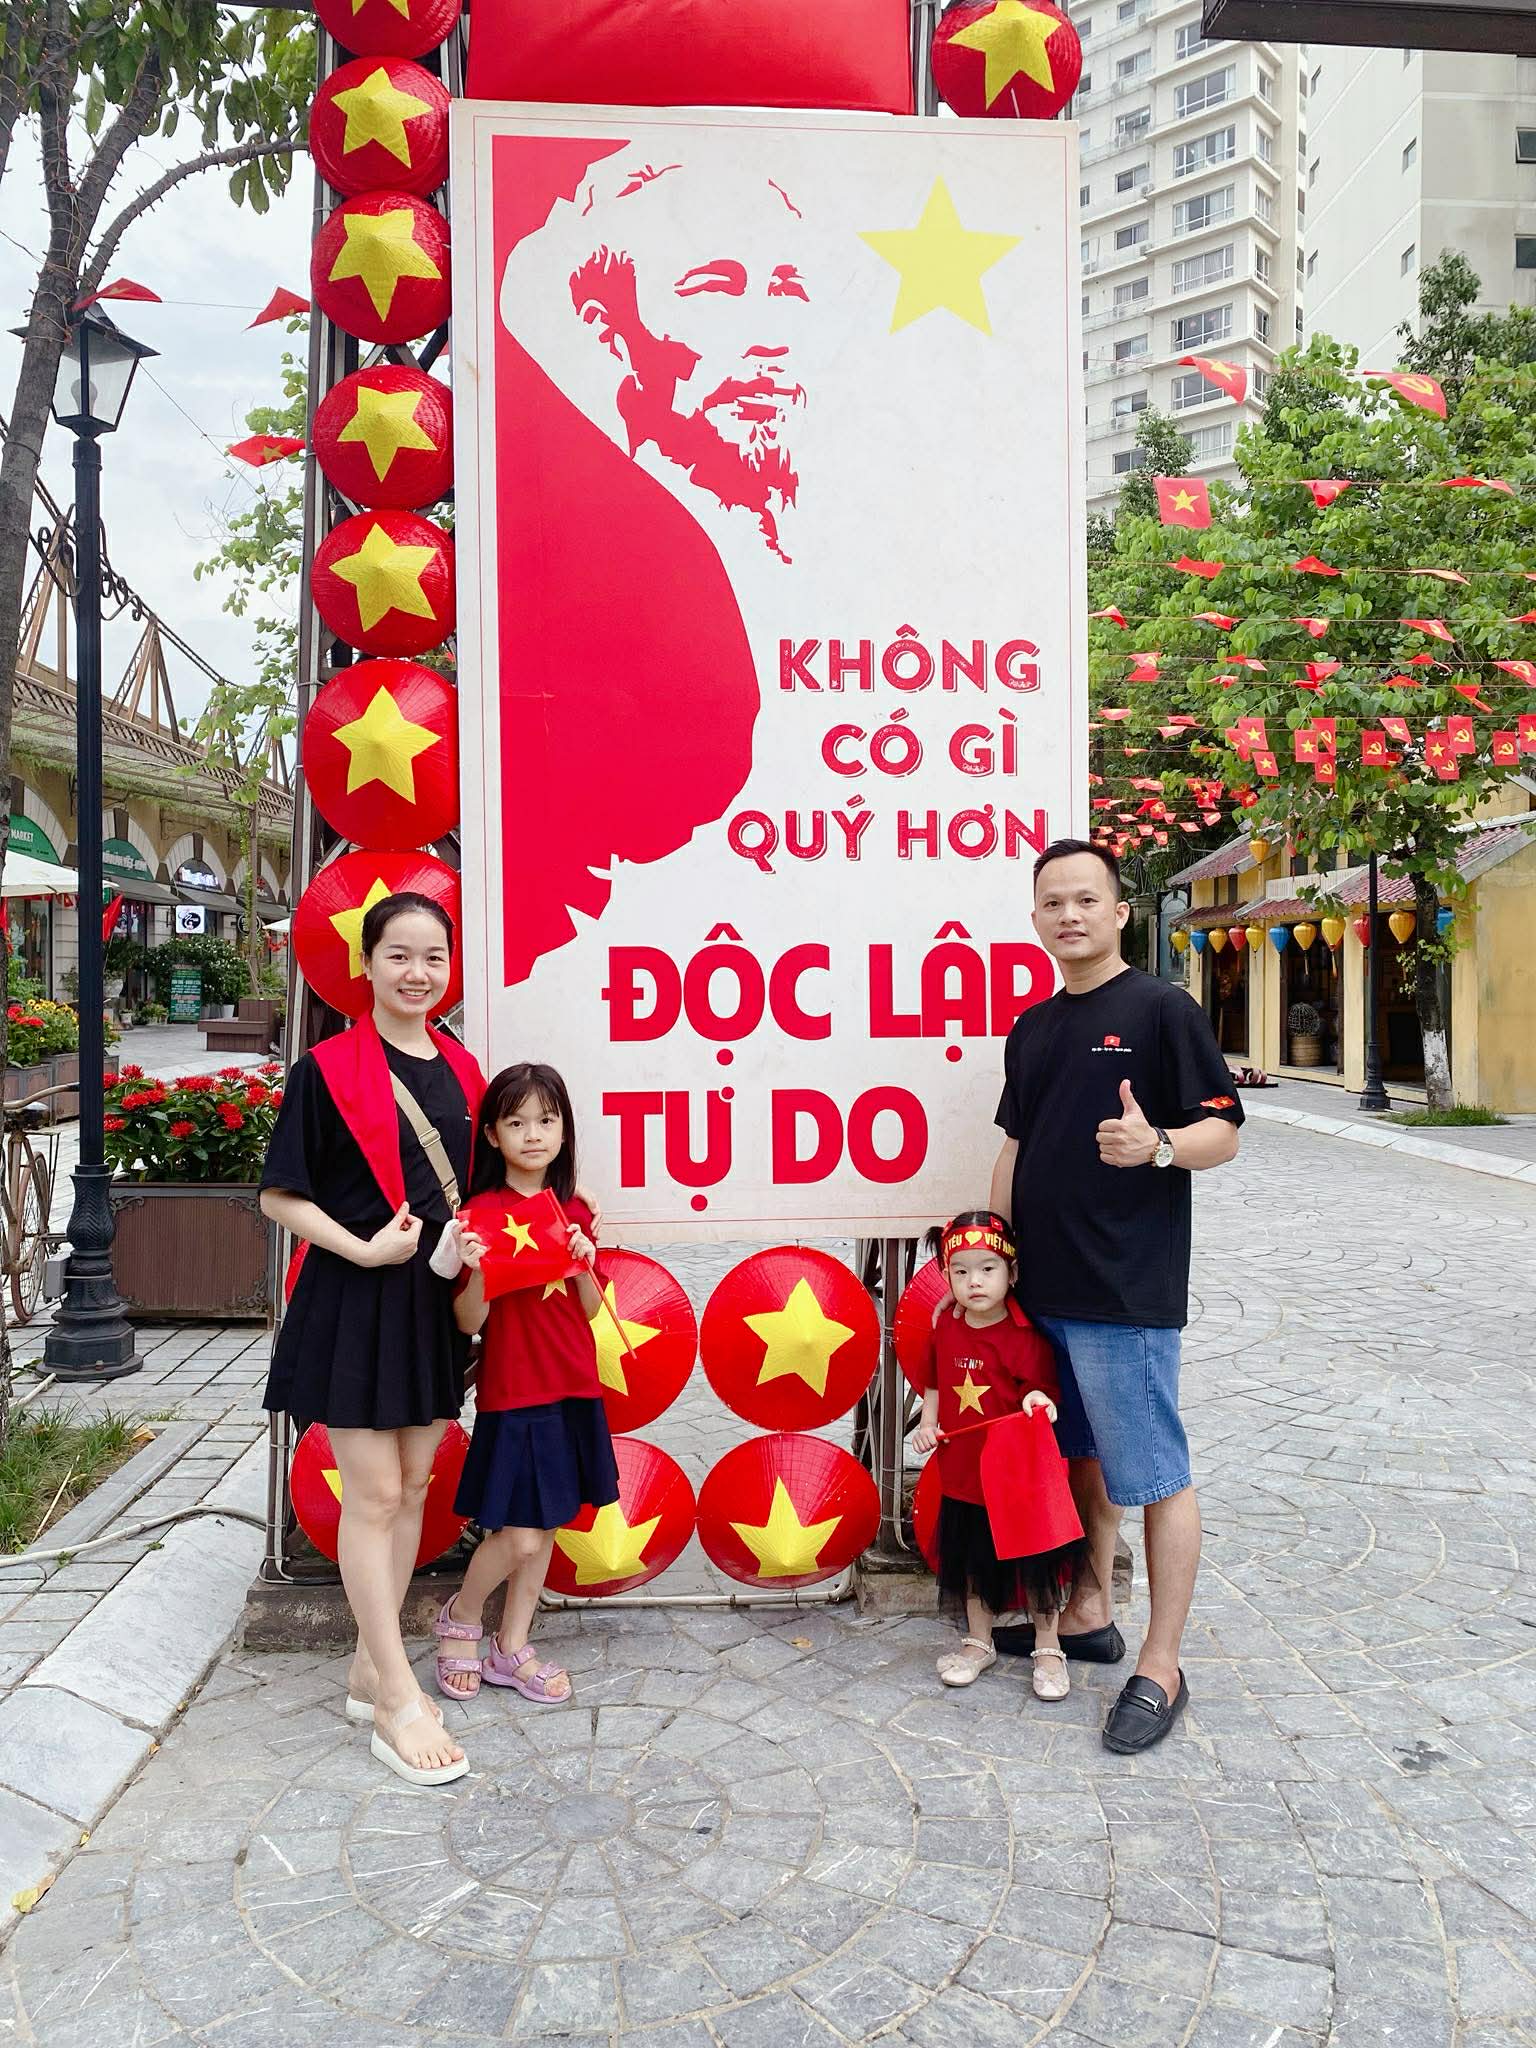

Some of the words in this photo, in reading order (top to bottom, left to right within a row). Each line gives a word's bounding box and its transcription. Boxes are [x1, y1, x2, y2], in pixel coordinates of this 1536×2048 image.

[778, 623, 1041, 693] KHÔNG
[820, 707, 924, 778] CÓ
[948, 707, 1018, 778] GÌ
[10, 829, 34, 843] MARKET
[727, 794, 875, 874] QUÝ
[897, 803, 1049, 861] HƠN
[601, 922, 832, 1066] ĐỘC
[868, 920, 1056, 1063] LẬP
[602, 1085, 736, 1212] TỰ
[771, 1085, 929, 1184] DO
[984, 1232, 1002, 1251] VIỆT
